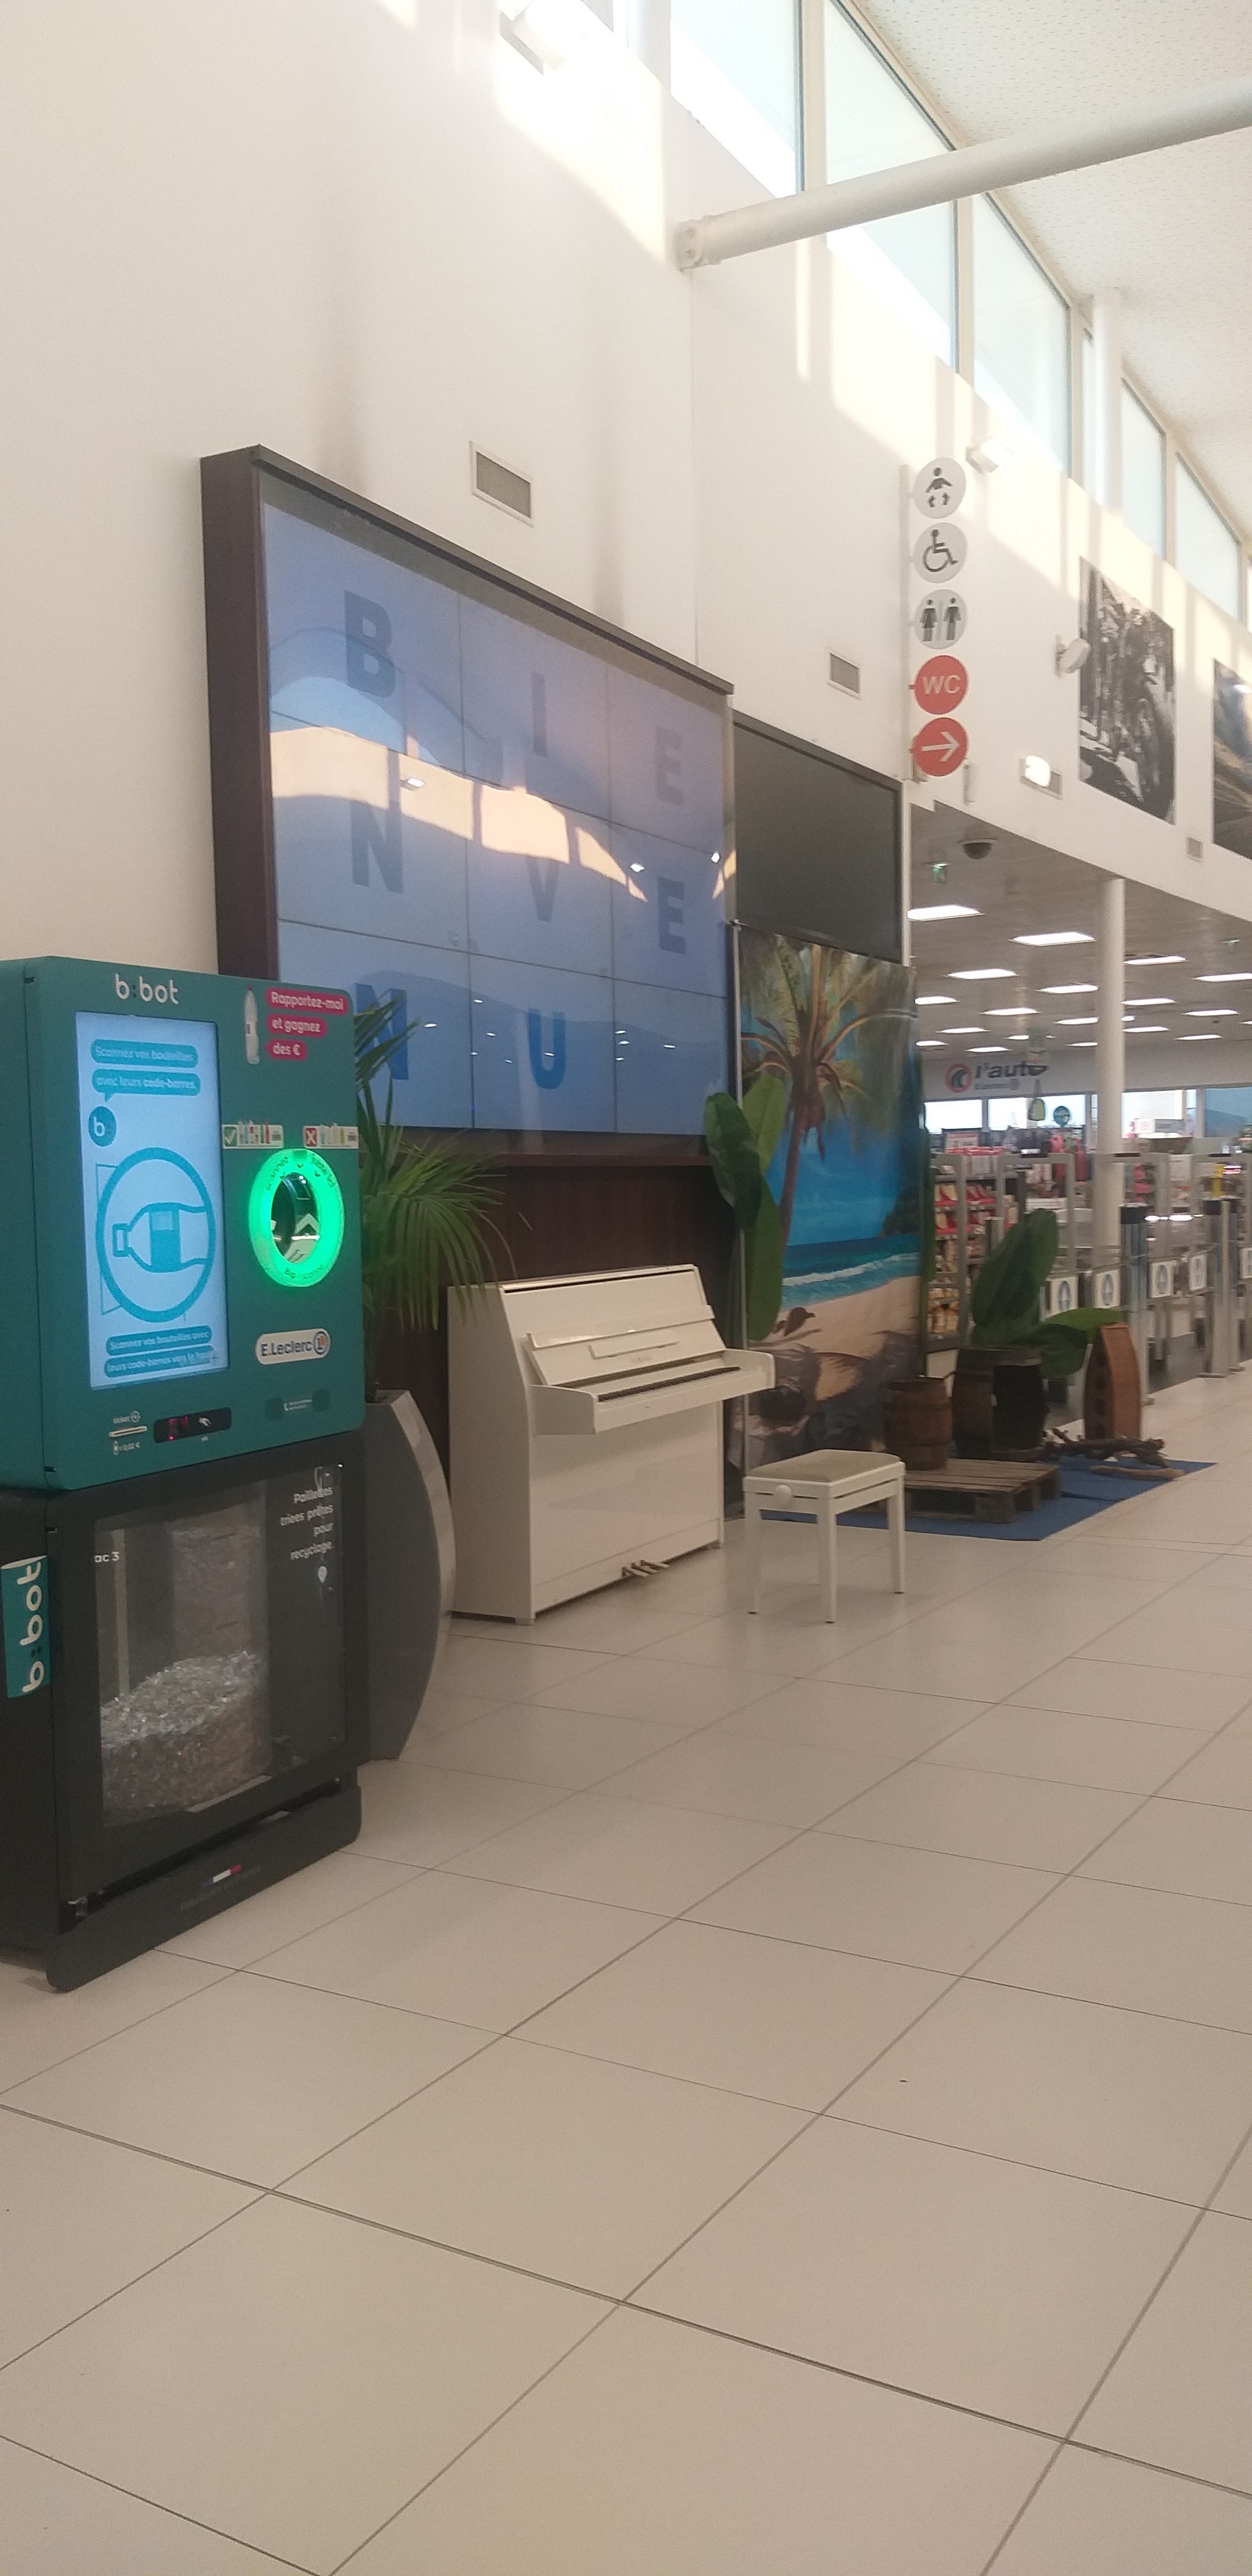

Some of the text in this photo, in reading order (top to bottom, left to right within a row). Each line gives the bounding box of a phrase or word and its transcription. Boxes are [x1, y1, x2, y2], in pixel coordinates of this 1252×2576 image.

[922, 675, 961, 694] WC
[344, 589, 396, 698] B
[655, 726, 683, 806] E
[350, 789, 404, 894] N
[657, 876, 686, 955] E
[271, 991, 344, 1011] Rapportez-moi
[272, 1017, 321, 1034] et gagnez
[272, 1042, 301, 1056] des €
[527, 1008, 566, 1090] U
[143, 1077, 196, 1090] code-barres
[260, 1340, 312, 1357] E.Leclerc
[314, 1522, 334, 1537] pour
[111, 1551, 120, 1561] 3
